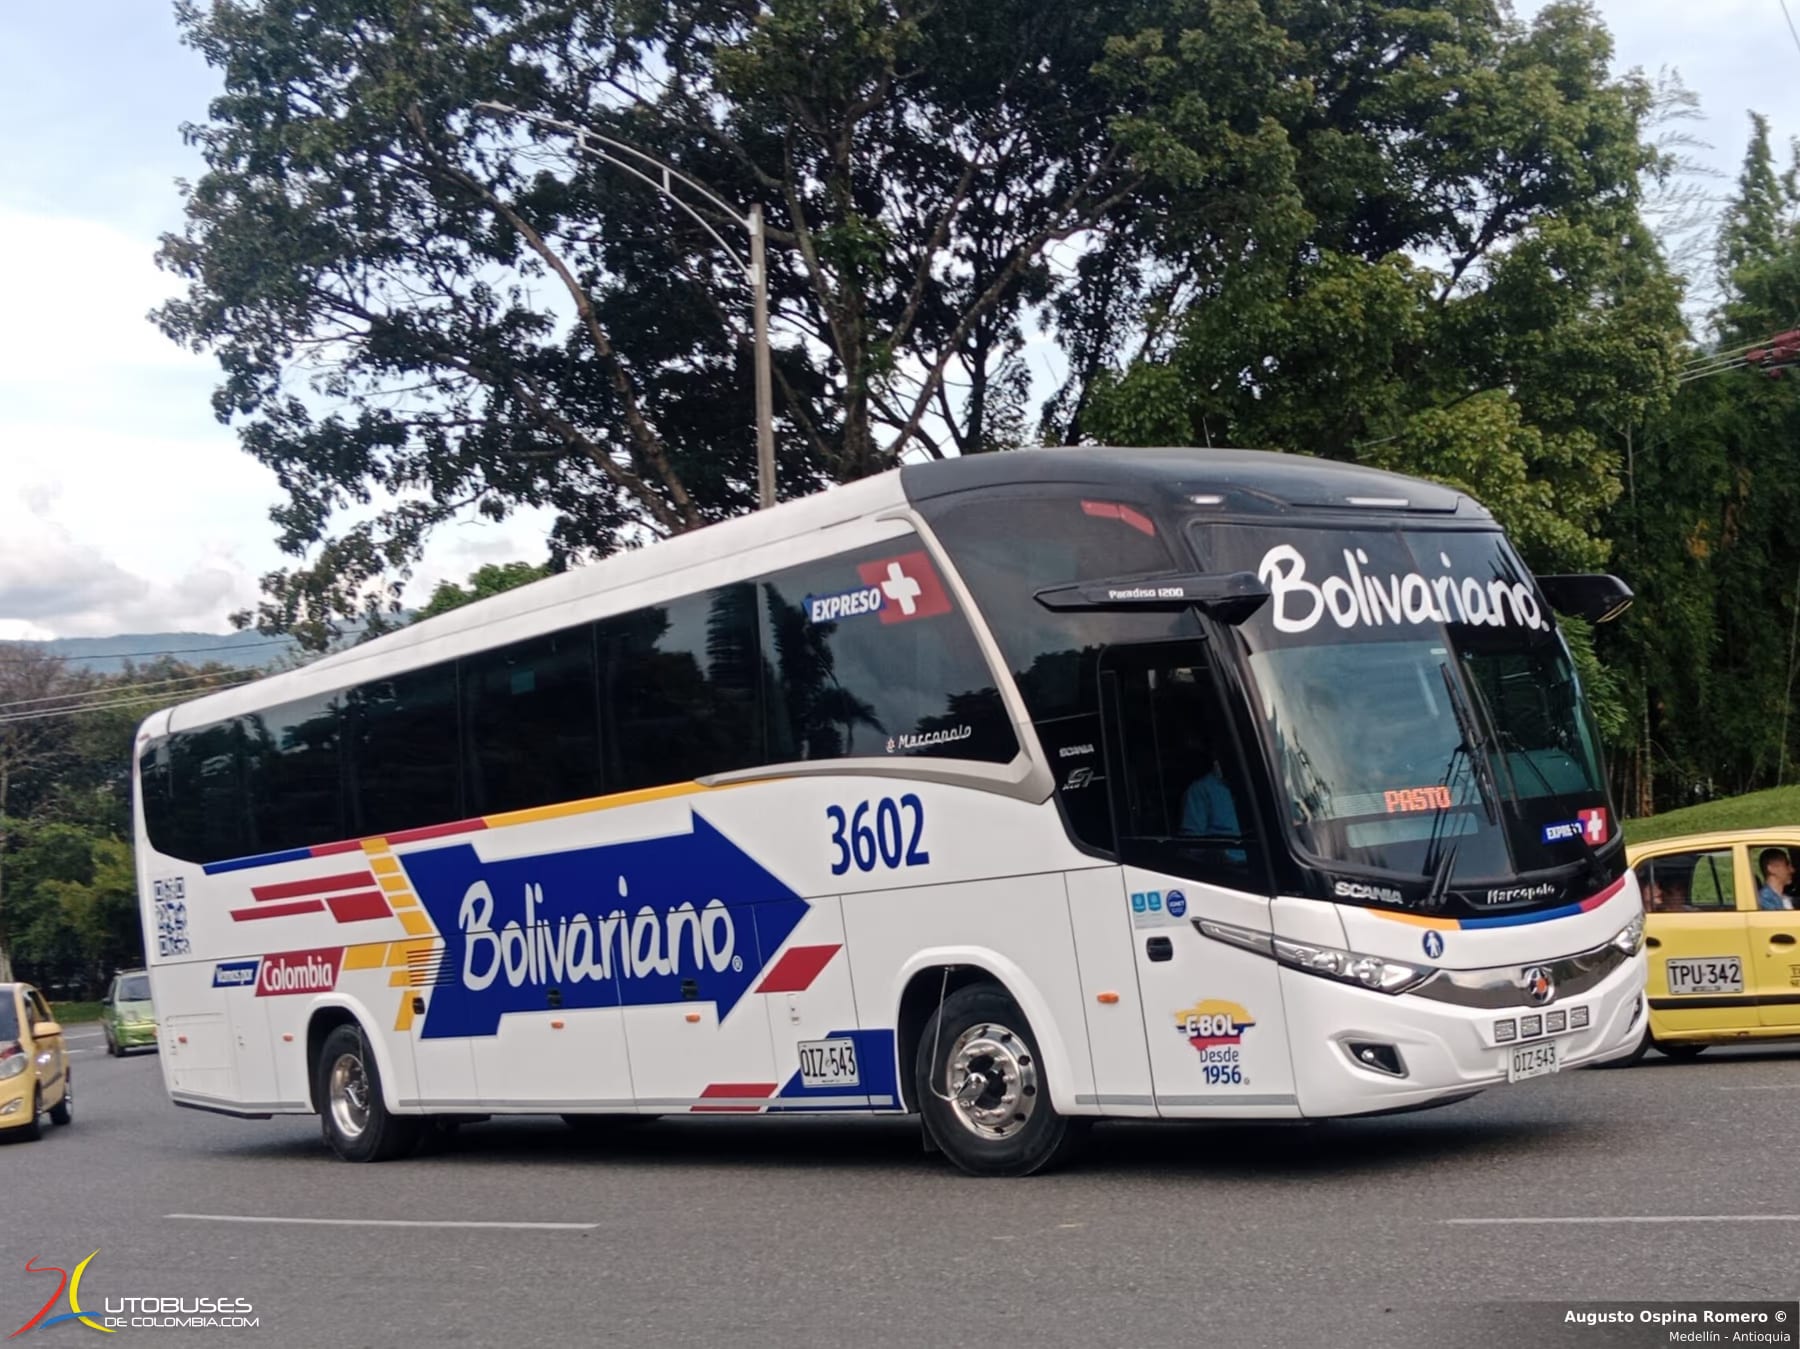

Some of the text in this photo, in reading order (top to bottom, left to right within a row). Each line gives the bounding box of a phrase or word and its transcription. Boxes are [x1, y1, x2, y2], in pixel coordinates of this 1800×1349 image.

[1108, 586, 1184, 600] Paradiso 1200
[1258, 544, 1542, 633] Bolivariano
[811, 587, 882, 623] EXPRESO
[898, 724, 972, 750] Marcopolo
[1059, 744, 1095, 757] SCANIA
[1384, 786, 1452, 813] PASTO
[825, 793, 930, 876] 3602
[1334, 881, 1404, 904] SCANIA
[1487, 883, 1555, 905] Marcopolo
[458, 875, 736, 991] Bolivariano
[262, 955, 333, 992] Colombia
[1200, 1046, 1239, 1063] Desde
[1202, 1064, 1242, 1085] 1956
